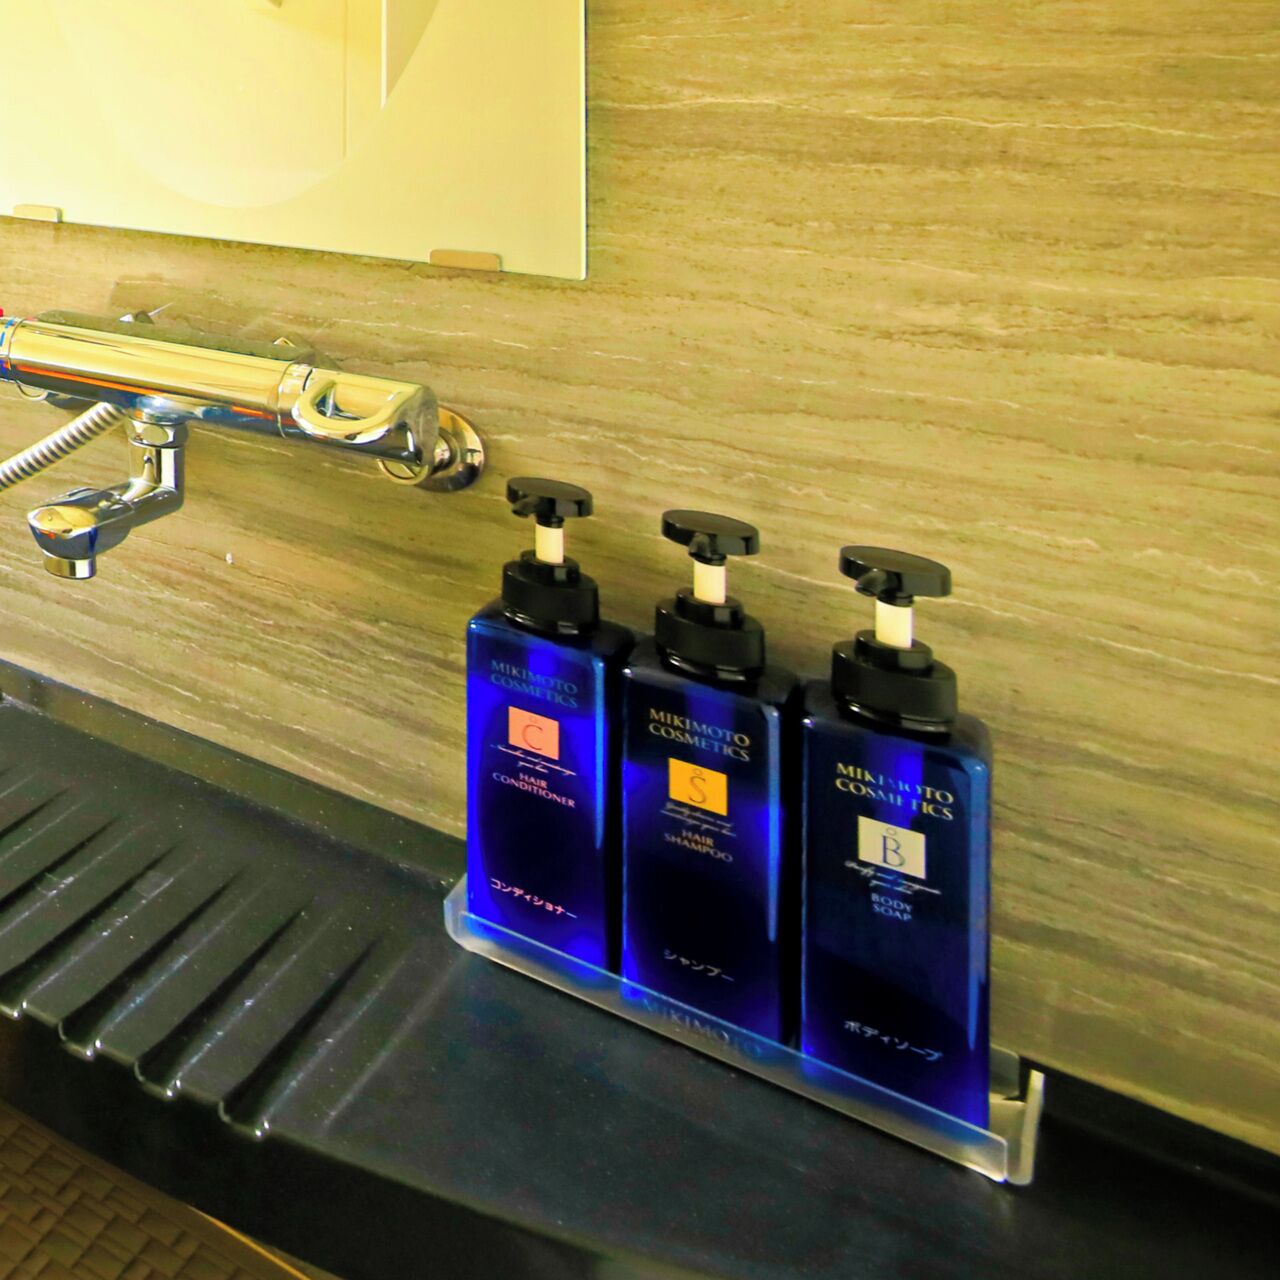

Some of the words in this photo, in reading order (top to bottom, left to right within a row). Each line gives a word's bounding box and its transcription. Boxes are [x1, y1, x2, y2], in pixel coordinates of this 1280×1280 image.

[490, 674, 578, 709] COSMETICS
[491, 659, 578, 695] MIKIMOTO
[648, 722, 750, 762] COSMETICS
[649, 707, 750, 748] MIKIMOTO
[491, 772, 576, 809] CONDITIONER
[518, 772, 548, 789] HAIR
[836, 762, 954, 804] MIKIMOTO
[835, 777, 954, 820] COSMETICS
[663, 832, 734, 863] SHAMPOO
[681, 829, 714, 847] HAIR
[881, 834, 906, 868] B
[490, 877, 578, 919] コンディショナー
[871, 892, 913, 913] BODY
[872, 903, 913, 922] SOAP
[664, 948, 735, 982] シャンプー
